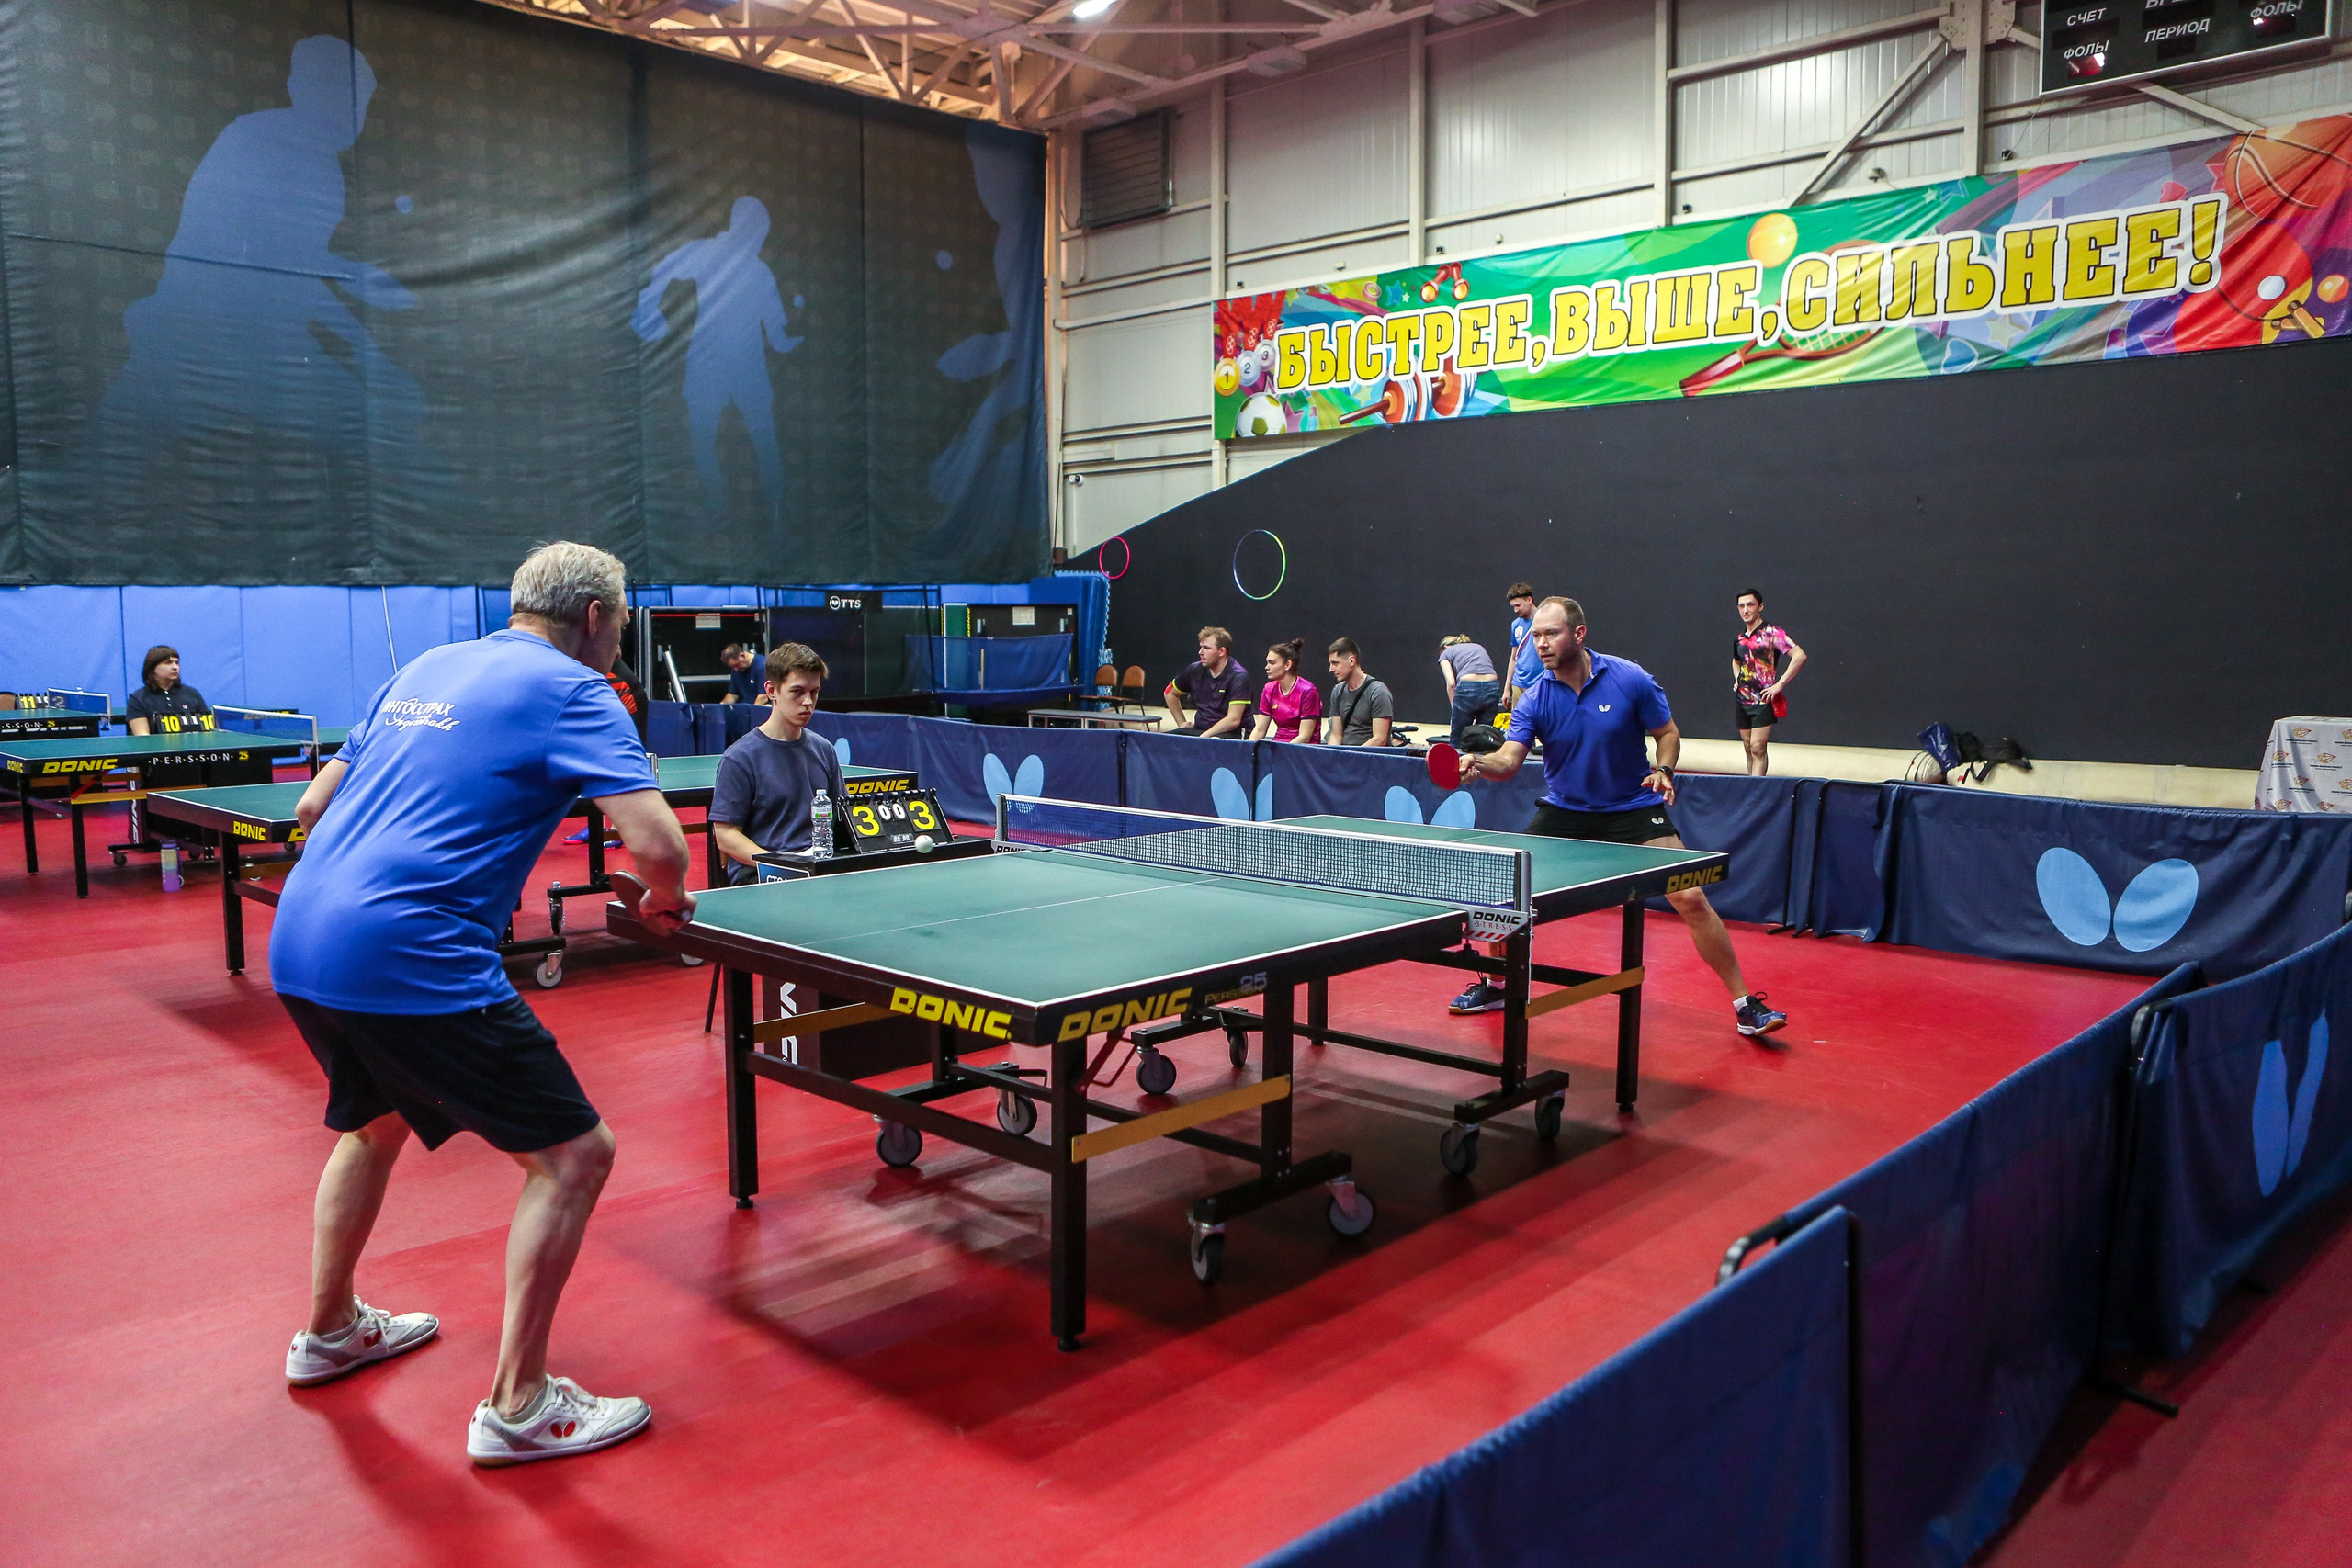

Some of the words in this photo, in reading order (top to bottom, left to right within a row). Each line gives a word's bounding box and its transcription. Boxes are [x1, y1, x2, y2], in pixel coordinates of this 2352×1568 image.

[2066, 7, 2107, 27] СЧЕТ
[2251, 0, 2302, 18] ФОЛЫ
[2144, 18, 2211, 43] ПЕРИОД
[2063, 39, 2110, 60] ФОЛЫ
[1243, 362, 1251, 374] 2
[840, 598, 862, 609] TTS
[161, 716, 182, 733] 10
[41, 758, 119, 774] DONIC
[845, 779, 910, 795] DONIC
[852, 805, 880, 837] 3
[877, 804, 891, 821] 0
[892, 802, 906, 820] 0
[908, 800, 936, 830] 3
[232, 820, 267, 841] DONIC
[1666, 865, 1724, 895] DONIC
[1473, 911, 1521, 925] DONIC
[889, 987, 1012, 1040] DONIC
[1057, 987, 1193, 1043] DONIC
